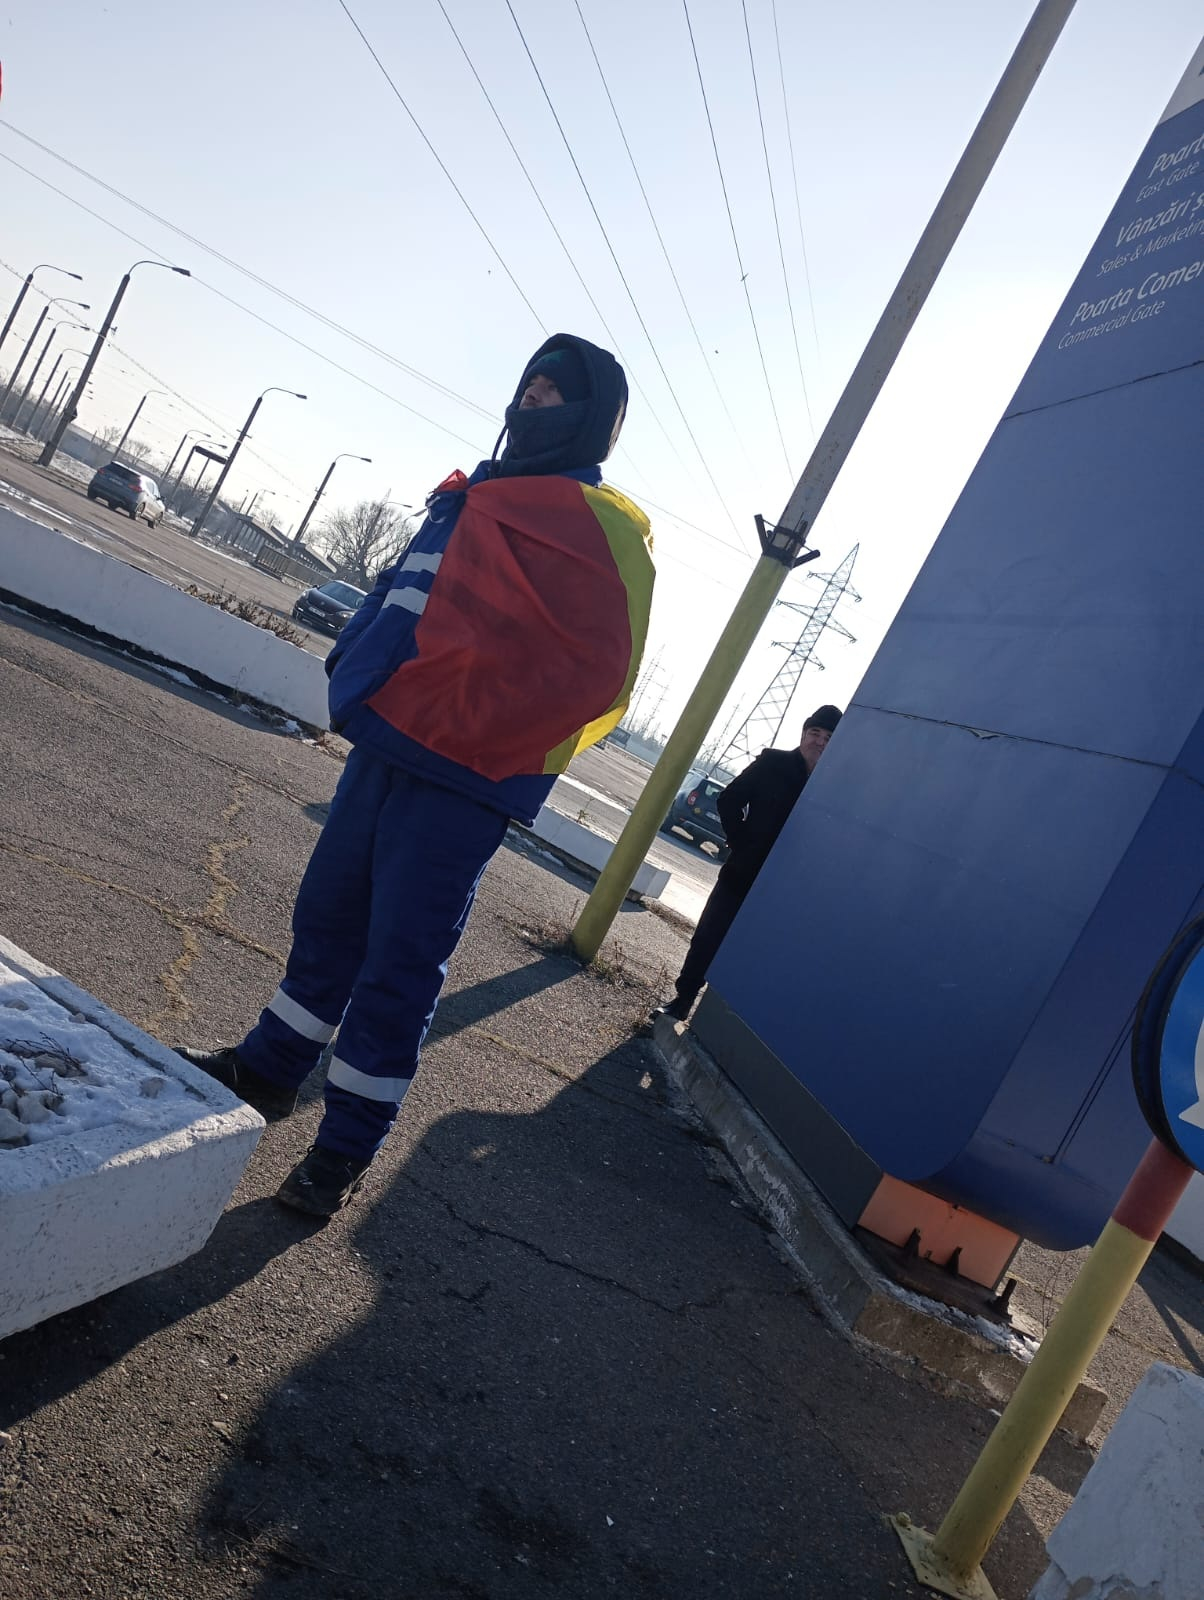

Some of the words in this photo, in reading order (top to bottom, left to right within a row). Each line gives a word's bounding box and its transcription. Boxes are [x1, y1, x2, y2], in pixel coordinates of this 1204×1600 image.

[1148, 132, 1204, 179] Poart
[1135, 177, 1165, 204] East
[1166, 161, 1200, 187] Gate
[1115, 192, 1197, 248] Vânzări
[1096, 252, 1131, 278] Sales
[1129, 243, 1143, 262] &
[1058, 308, 1134, 350] Commercial
[1131, 300, 1166, 323] Gate
[1069, 287, 1135, 328] Poarta
